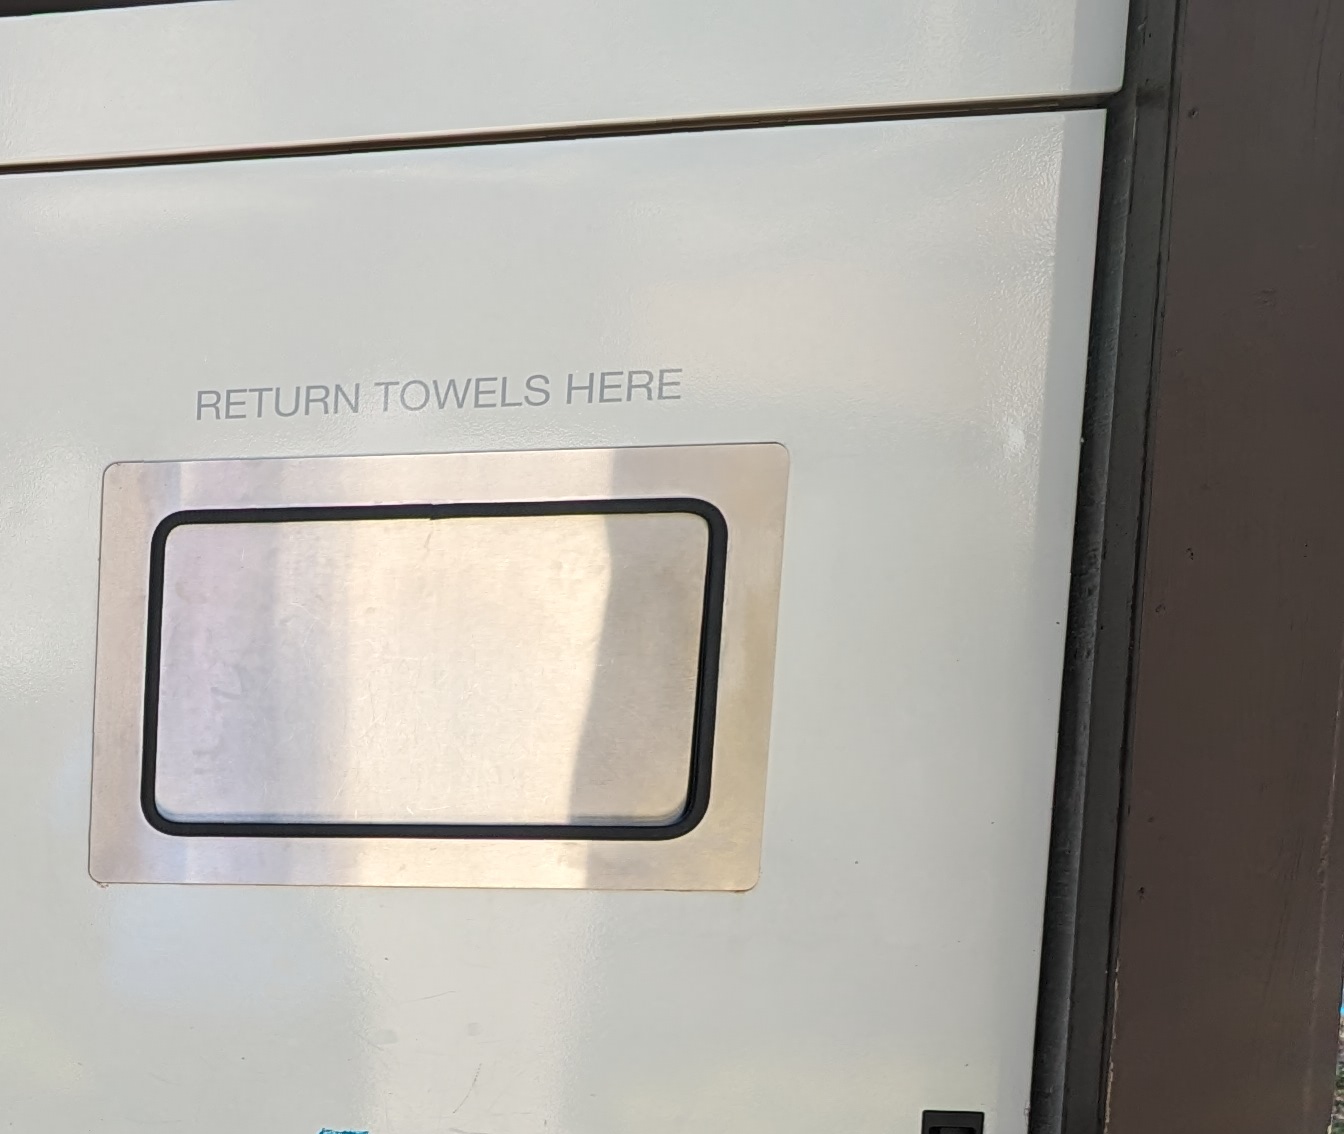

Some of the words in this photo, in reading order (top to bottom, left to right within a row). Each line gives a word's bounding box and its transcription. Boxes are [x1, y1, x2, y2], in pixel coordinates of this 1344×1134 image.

[196, 383, 359, 421] RETURN
[375, 373, 551, 412] TOWELS
[566, 368, 684, 405] HERE
